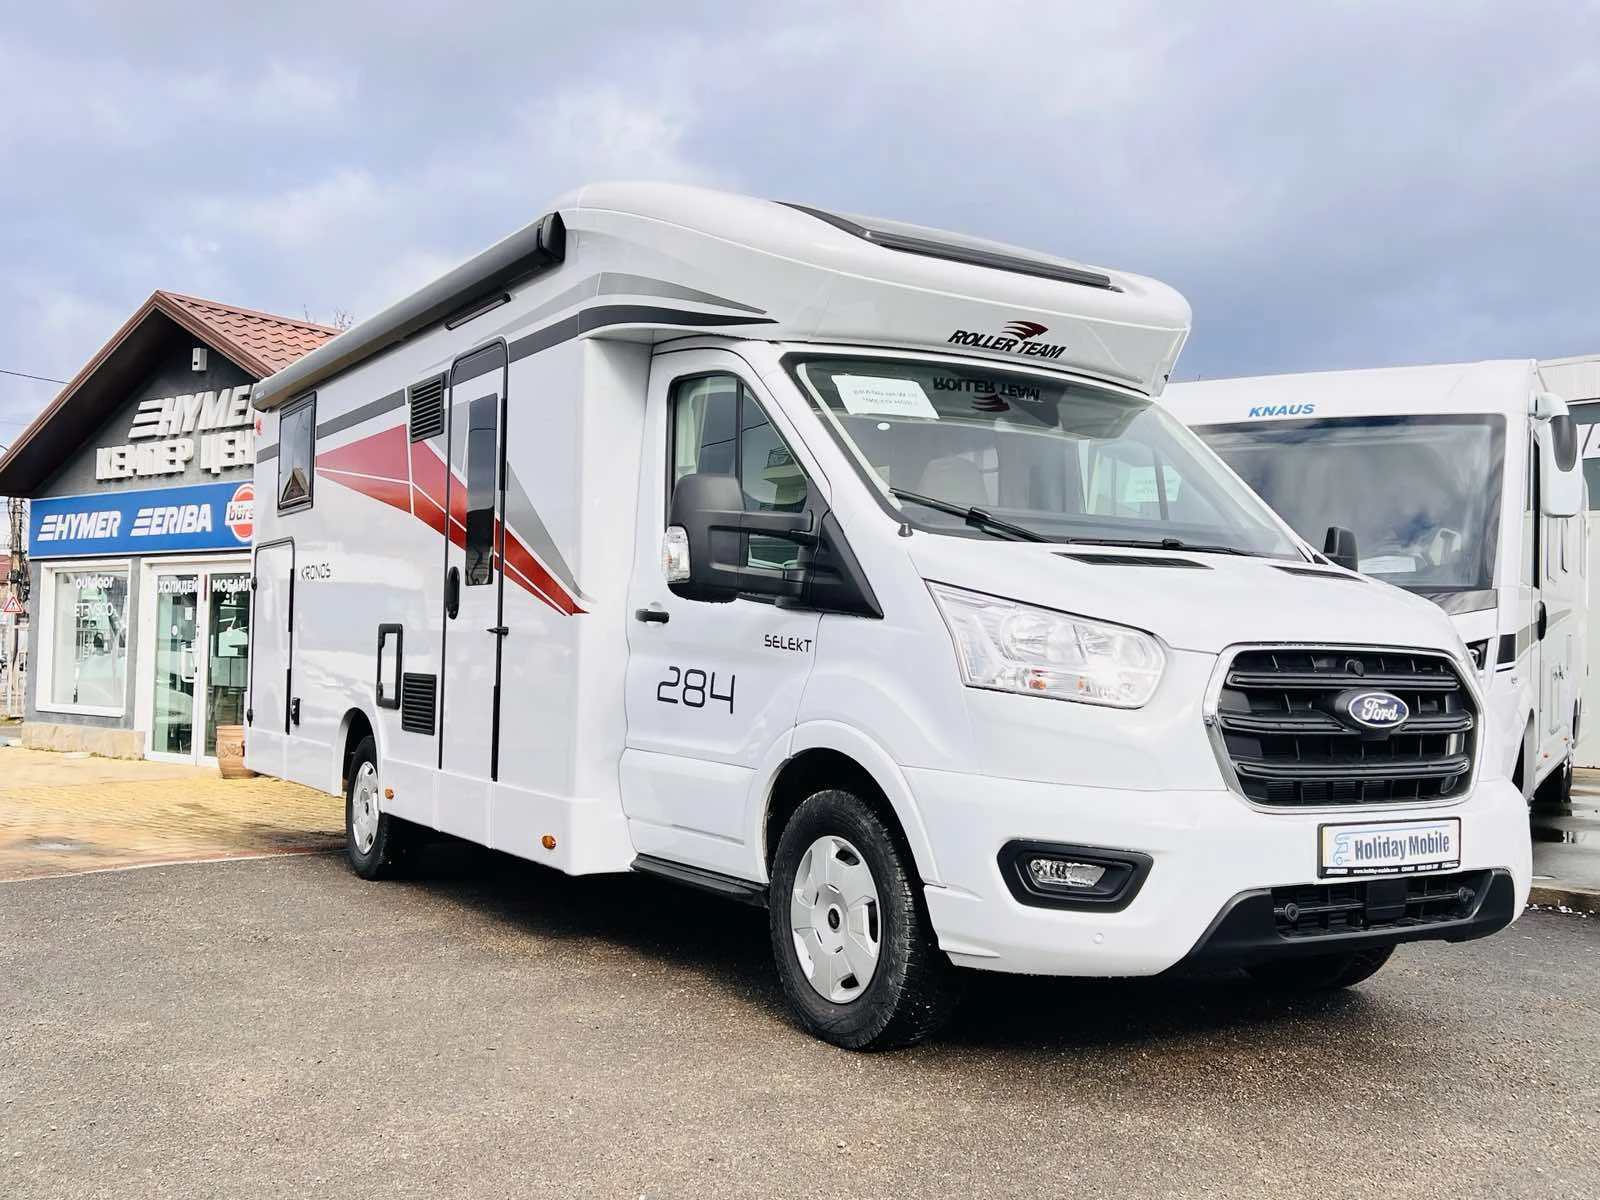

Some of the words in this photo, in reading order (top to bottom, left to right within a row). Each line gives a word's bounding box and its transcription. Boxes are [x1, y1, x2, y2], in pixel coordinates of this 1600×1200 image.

[947, 329, 1019, 352] ROLLER
[1017, 341, 1067, 359] TEAM
[1248, 403, 1315, 417] KNAUS
[37, 510, 122, 541] HYMER
[130, 503, 213, 536] ERIBA
[301, 563, 331, 581] KRONOS
[159, 576, 198, 595] ХОЛИДЕЙ
[764, 634, 812, 652] SELEKT
[657, 666, 735, 714] 284
[1362, 697, 1398, 720] Ford
[1354, 835, 1407, 860] Holiday
[1408, 831, 1450, 857] Mobile
